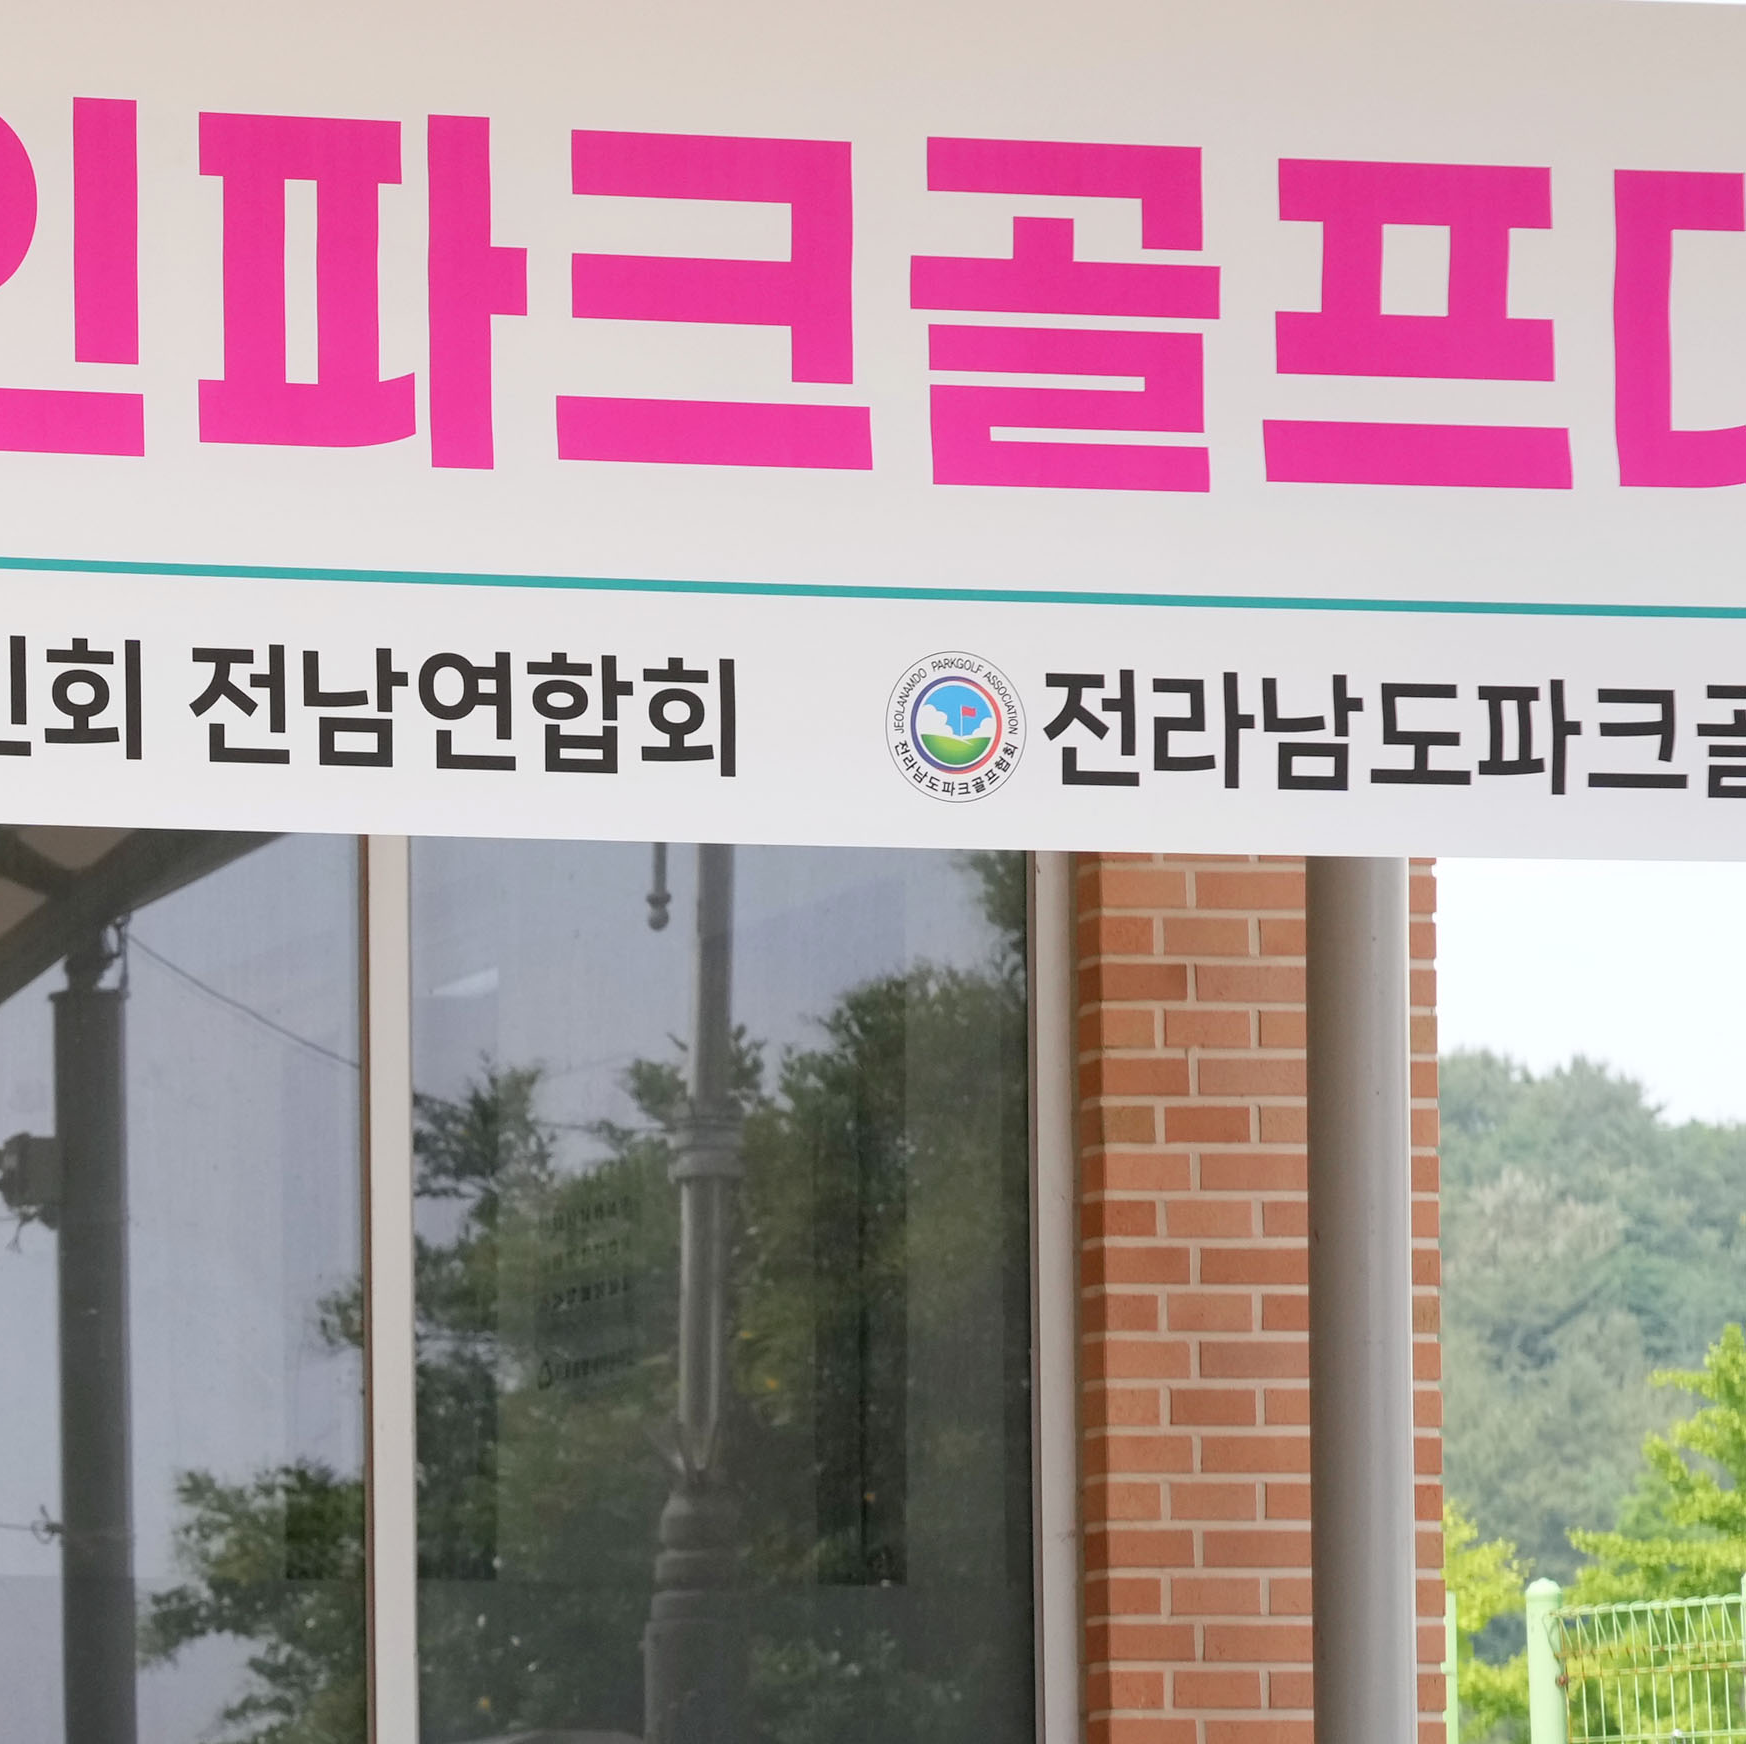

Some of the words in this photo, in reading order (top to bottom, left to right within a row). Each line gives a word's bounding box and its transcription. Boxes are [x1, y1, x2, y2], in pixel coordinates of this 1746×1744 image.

[189, 644, 736, 778] 전남연합회
[931, 658, 984, 673] PARKGOLF
[983, 671, 1018, 735] ASSOCIATION
[894, 740, 1019, 796] 전라남도파크골프협회
